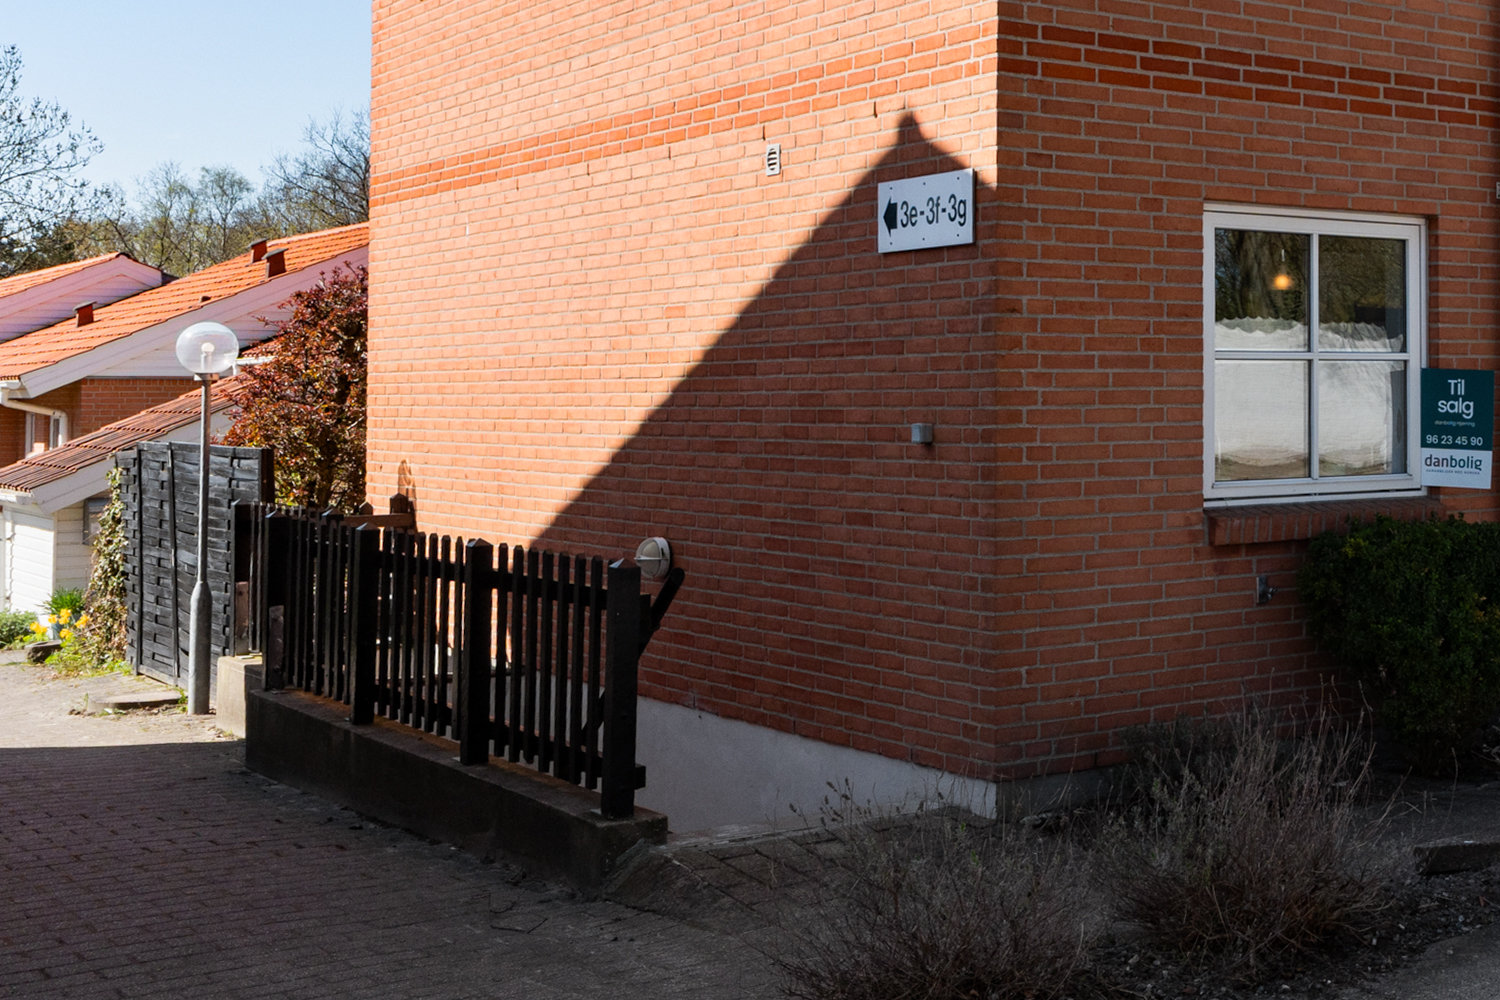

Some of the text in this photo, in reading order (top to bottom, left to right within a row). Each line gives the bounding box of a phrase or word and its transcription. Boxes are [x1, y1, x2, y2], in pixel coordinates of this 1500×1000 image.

[1447, 379, 1465, 395] Til
[1437, 397, 1474, 419] salg
[1426, 434, 1483, 446] 96 23 45 90
[1424, 454, 1482, 471] danbolig
